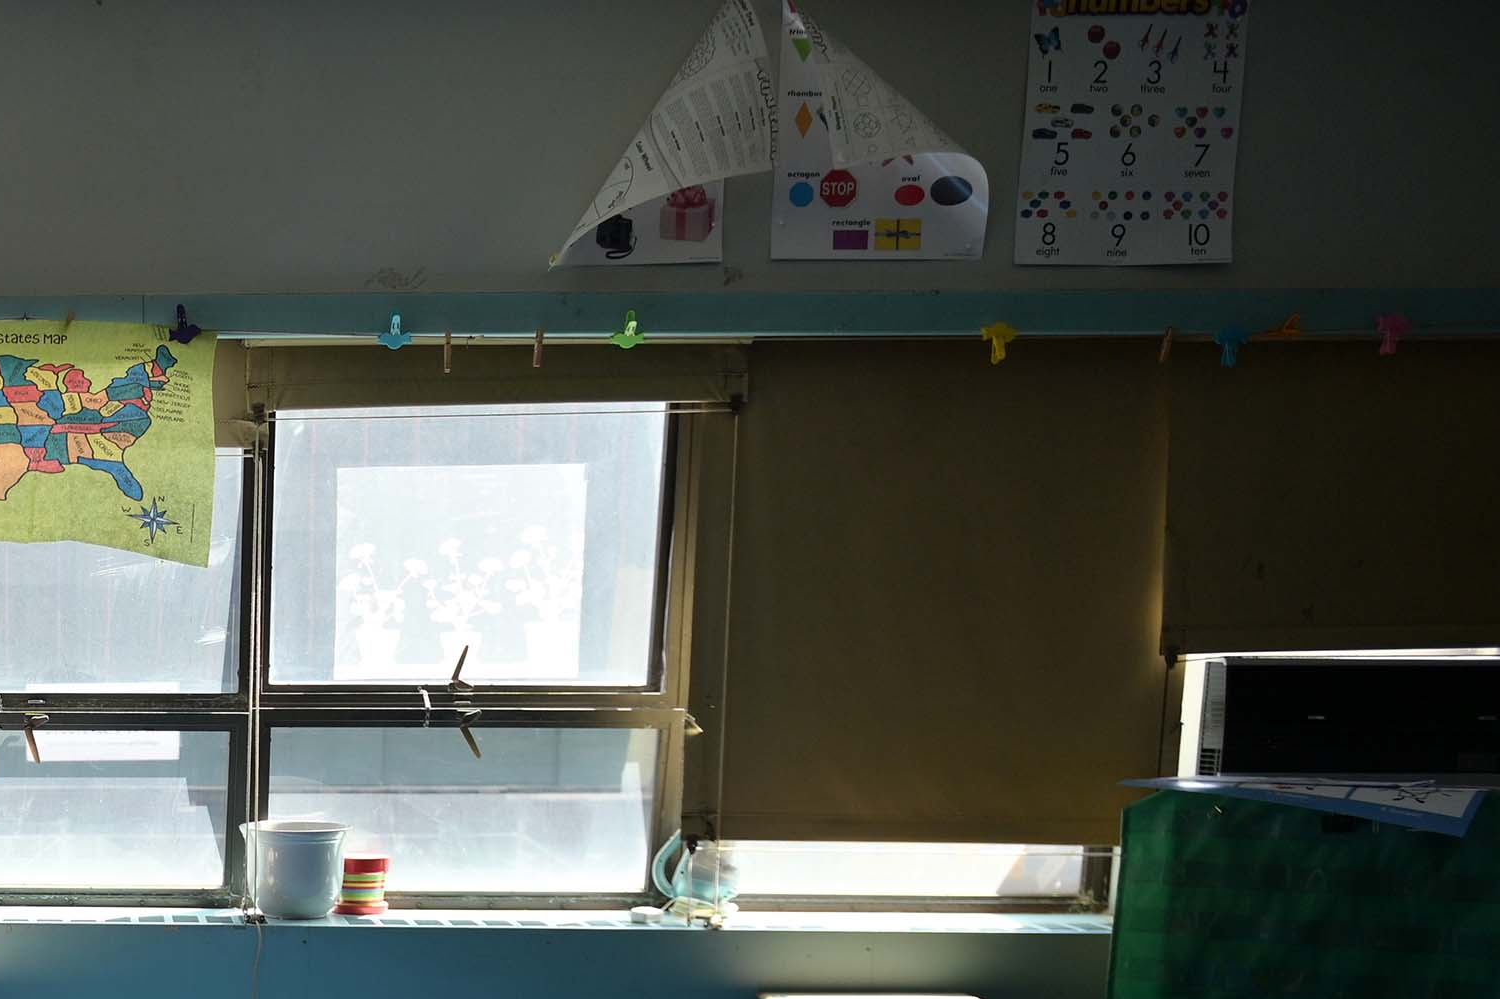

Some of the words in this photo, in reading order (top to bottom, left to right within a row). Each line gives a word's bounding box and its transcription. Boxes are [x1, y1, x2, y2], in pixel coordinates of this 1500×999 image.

[1046, 60, 1053, 83] 1
[1093, 60, 1108, 84] 2
[1145, 60, 1162, 84] 3
[1212, 60, 1229, 83] 4
[1039, 85, 1058, 93] one
[1089, 84, 1109, 93] two
[1140, 84, 1166, 93] three
[1211, 83, 1232, 93] four
[1053, 142, 1069, 166] 5
[1120, 143, 1136, 166] 6
[1194, 144, 1210, 167] 7
[1050, 167, 1068, 177] five
[1120, 168, 1134, 177] six
[1184, 170, 1211, 178] seven
[821, 182, 855, 196] STOP
[832, 219, 871, 227] rectangle
[1041, 223, 1056, 245] 8
[1110, 224, 1126, 247] 9
[1188, 223, 1211, 246] 10
[1035, 247, 1060, 257] eight
[1106, 248, 1127, 257] nine
[1190, 248, 1207, 256] ten
[43, 336, 68, 345] Map
[176, 526, 183, 534] E
[143, 539, 150, 547] S
